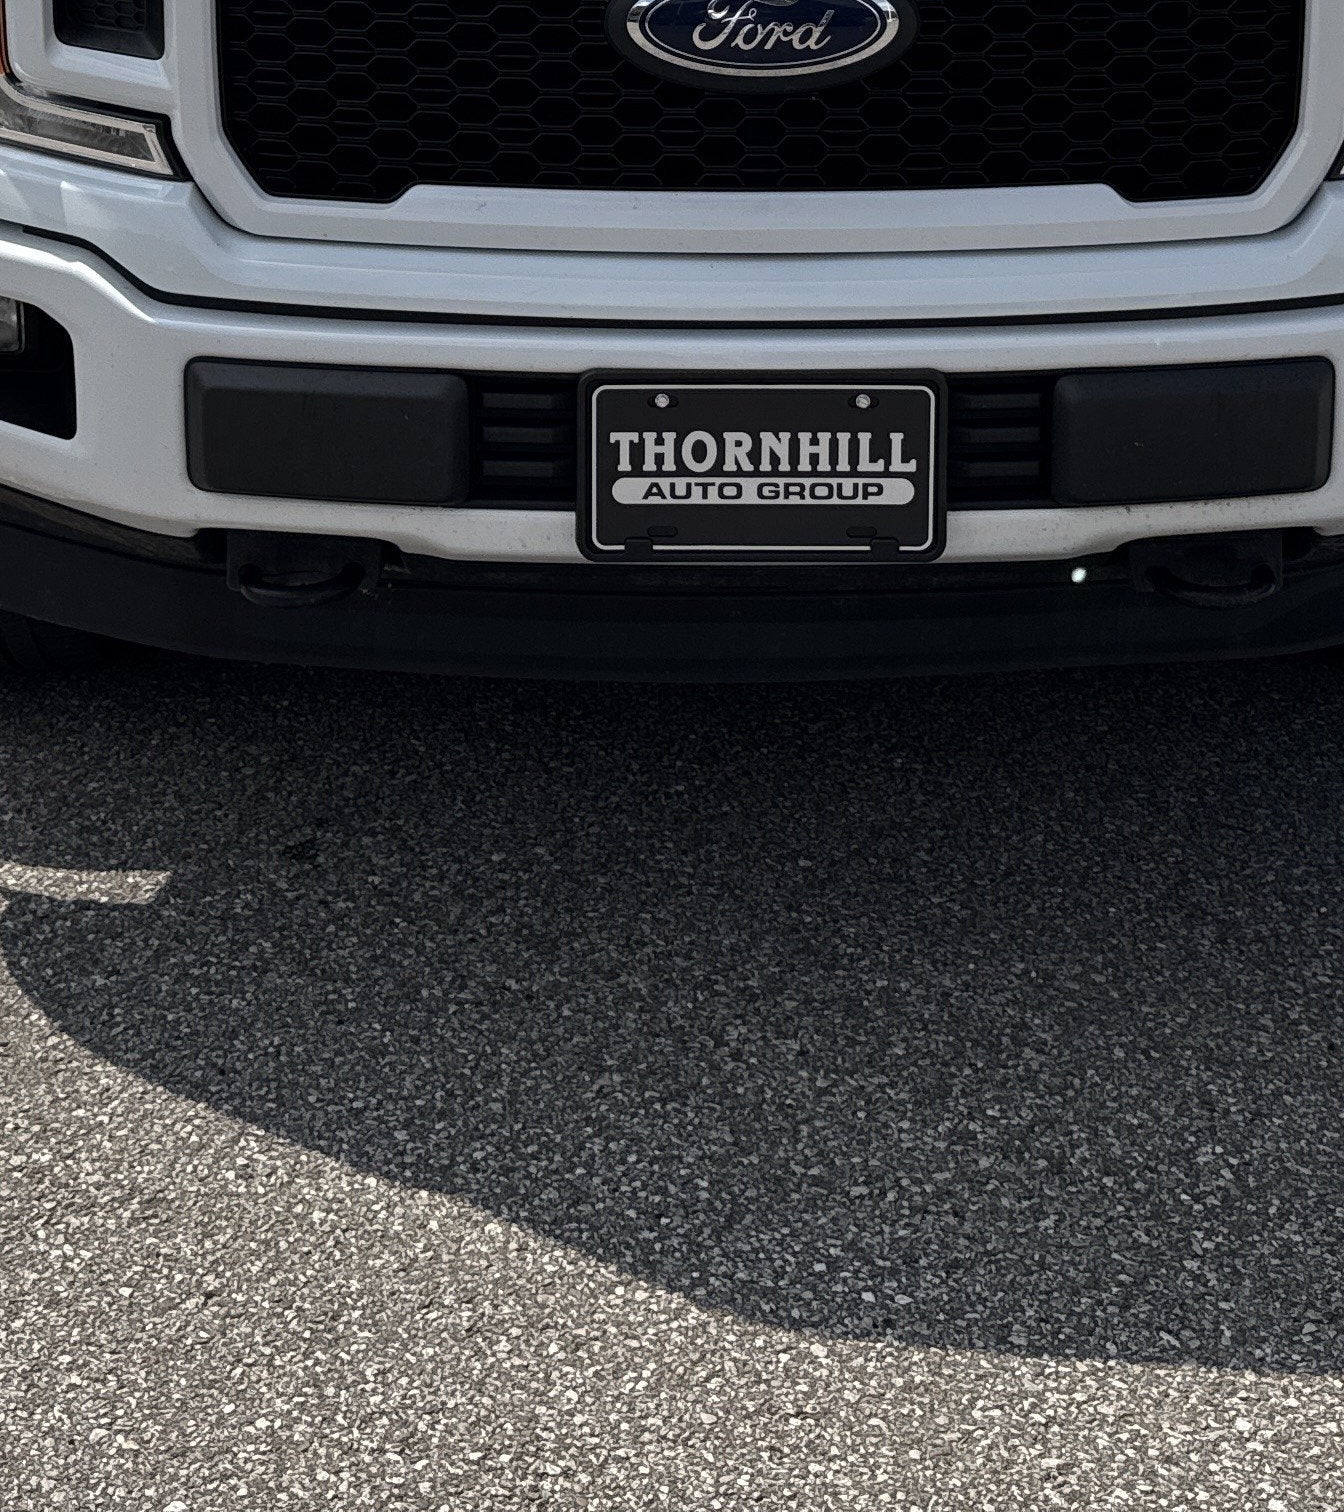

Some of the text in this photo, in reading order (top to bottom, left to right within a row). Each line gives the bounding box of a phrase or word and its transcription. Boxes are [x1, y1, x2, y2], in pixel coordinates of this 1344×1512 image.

[609, 430, 917, 473] THORNHILL
[642, 481, 884, 500] AUTO GROUP
